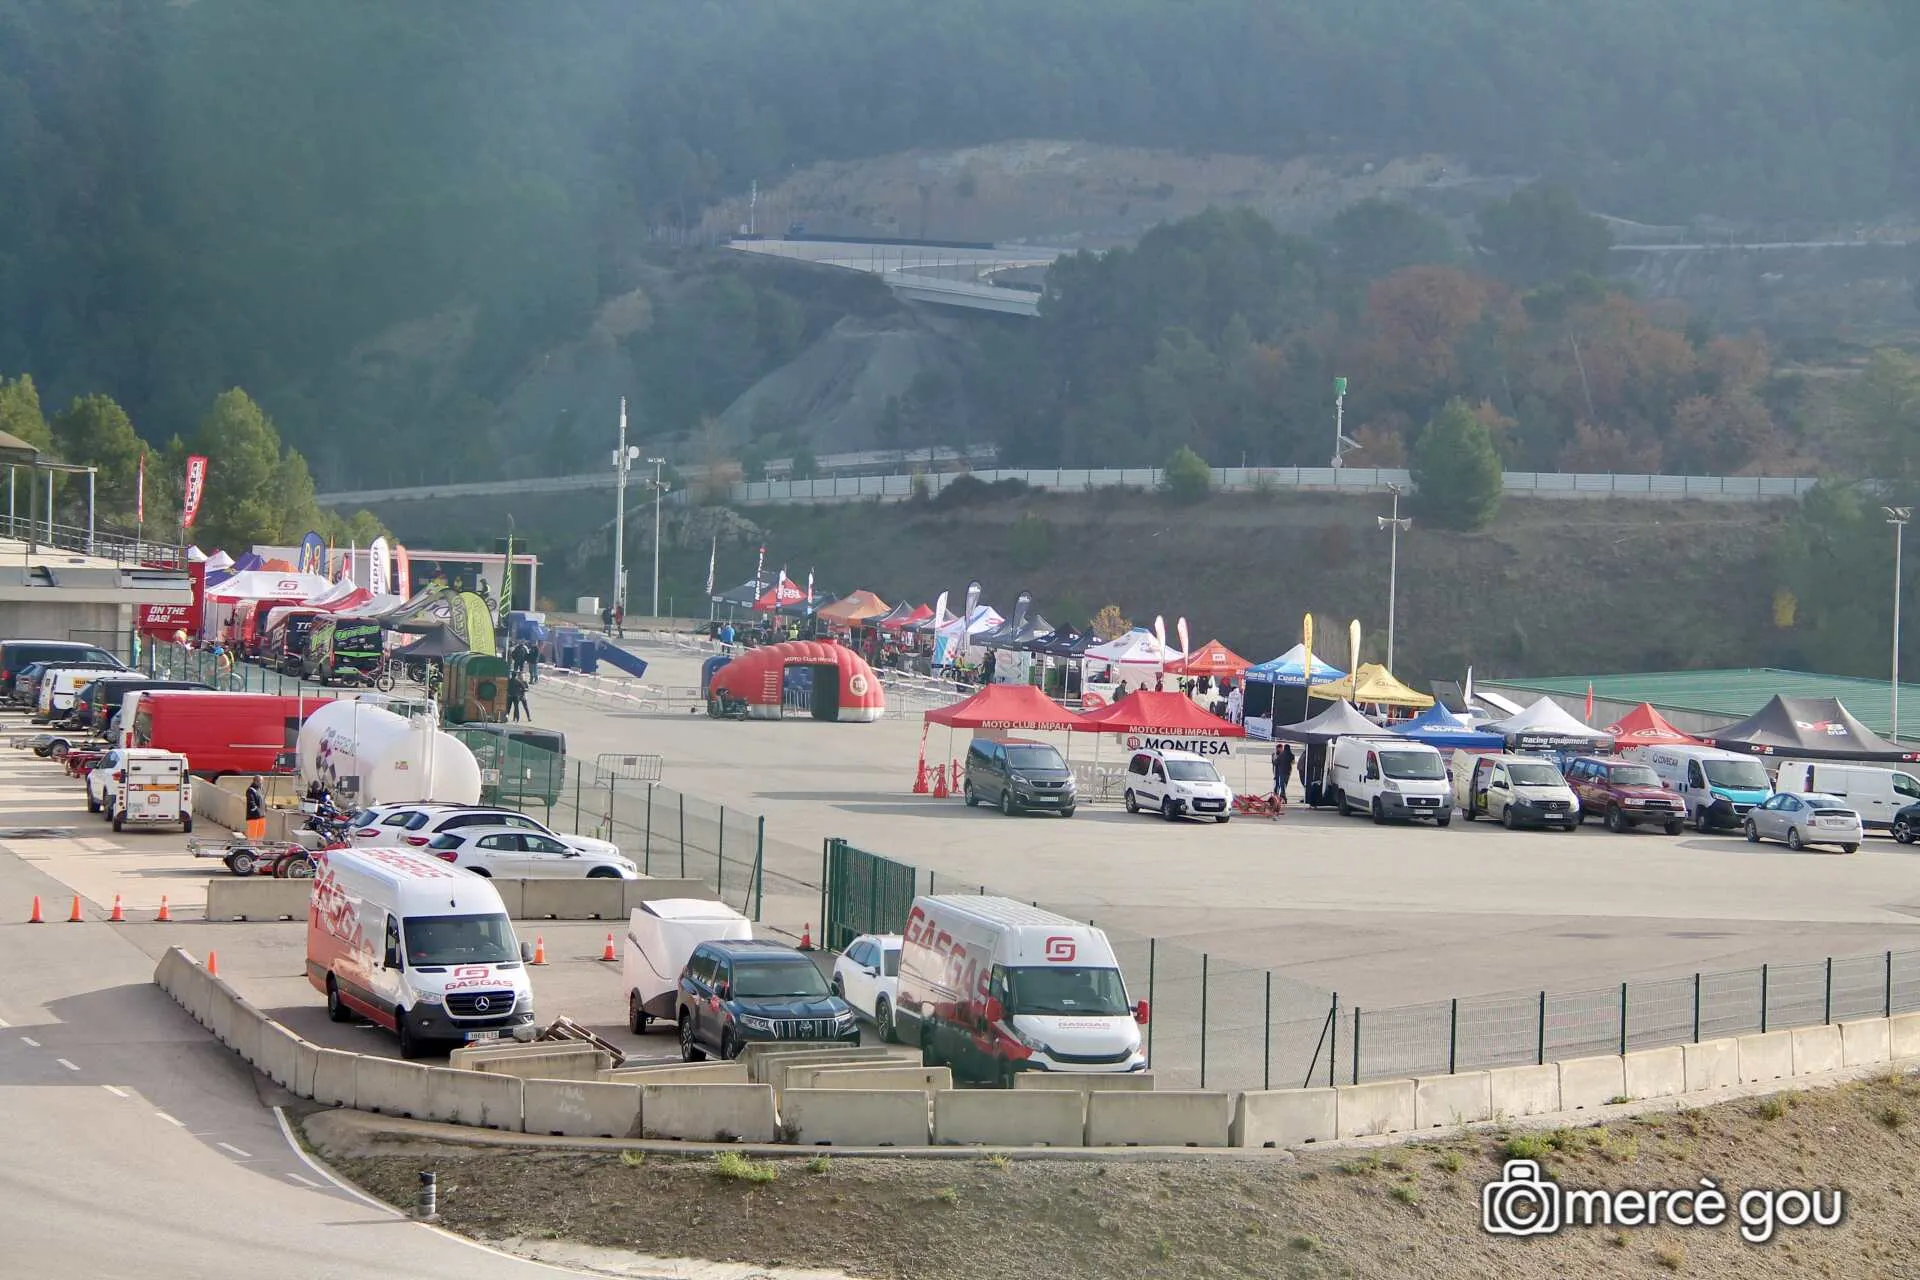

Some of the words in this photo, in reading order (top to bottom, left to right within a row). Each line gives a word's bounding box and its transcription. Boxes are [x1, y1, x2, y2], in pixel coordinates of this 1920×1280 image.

[150, 606, 165, 614] ON
[167, 607, 186, 615] THE
[147, 614, 170, 623] GAS!
[982, 720, 1012, 728] MOTO
[1013, 721, 1036, 729] CLUB
[1038, 722, 1073, 730] IMPALA
[1130, 725, 1158, 734] MOTO
[1160, 727, 1183, 735] CLUB
[1185, 728, 1220, 737] IMPALA
[1145, 736, 1230, 755] MONTESA
[1522, 736, 1548, 745] Racing
[1549, 737, 1589, 745] Equipment
[445, 980, 514, 990] GASGAS
